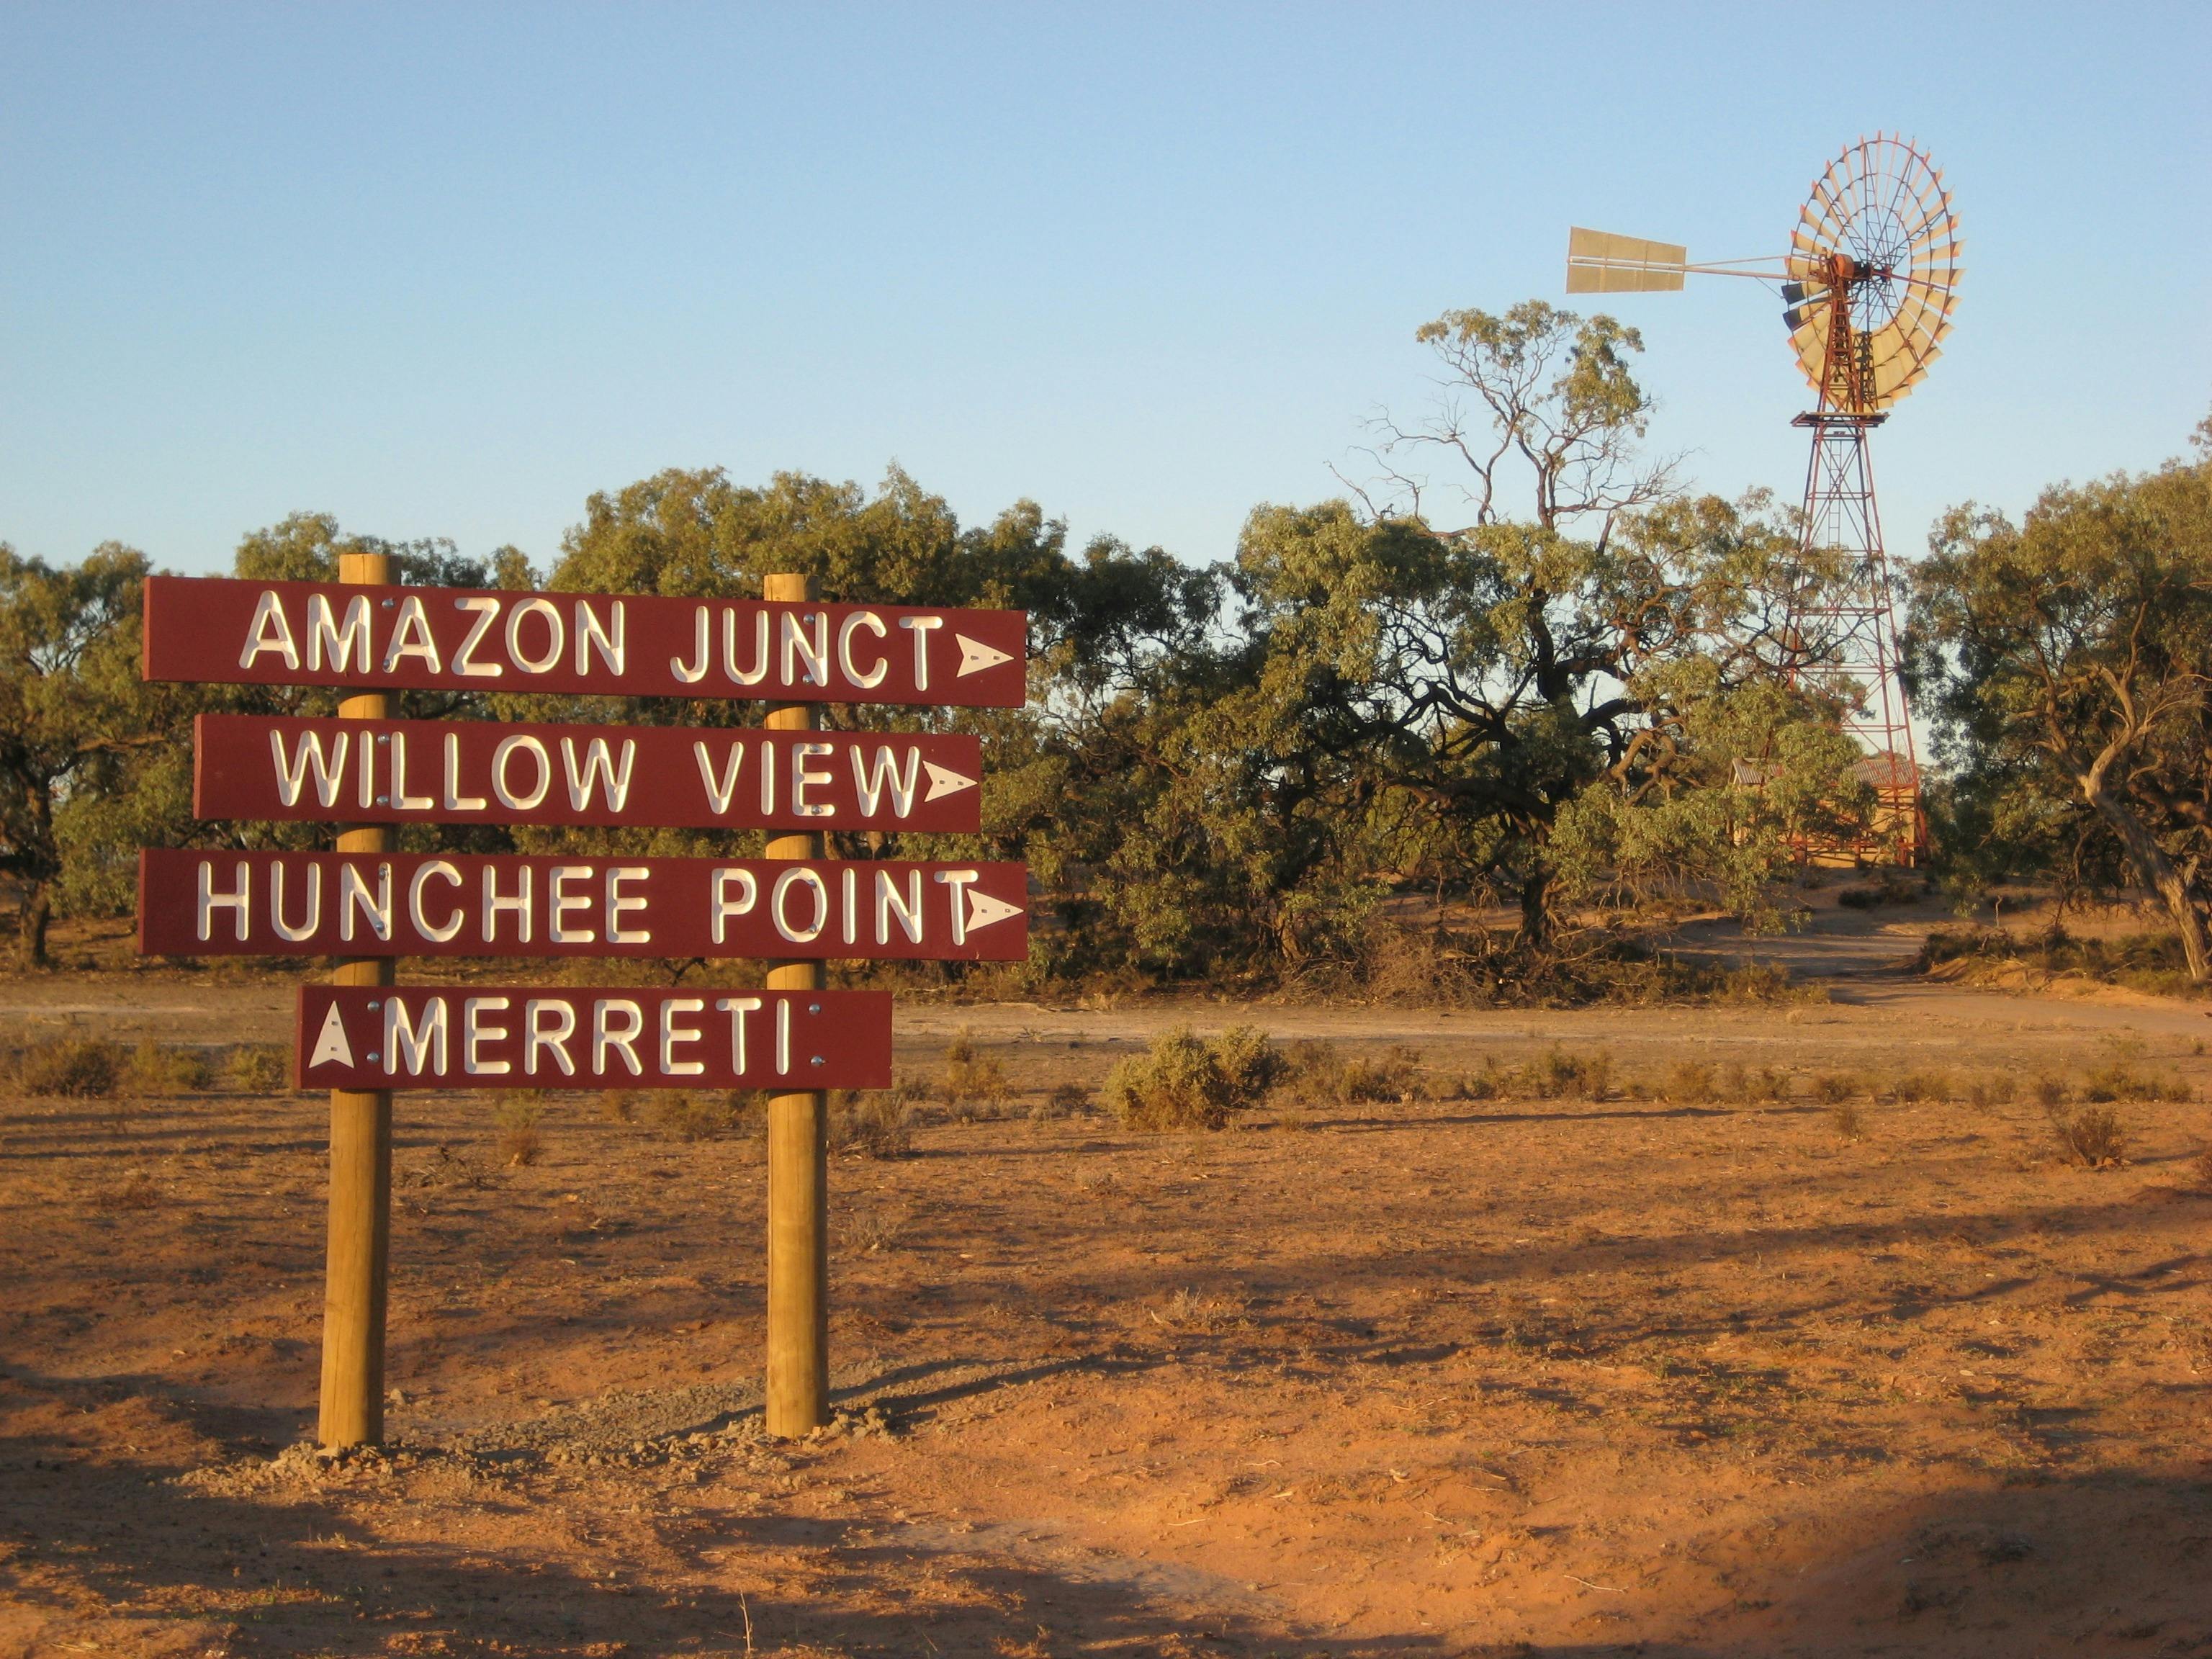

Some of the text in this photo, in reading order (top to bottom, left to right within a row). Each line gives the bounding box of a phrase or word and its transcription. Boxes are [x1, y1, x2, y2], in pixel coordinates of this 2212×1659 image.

[239, 590, 943, 691] AMAZON JUNCT
[270, 729, 920, 819] WILLOW VIEW
[197, 860, 979, 946] HUNCHEE POINT
[383, 996, 789, 1076] MERRETI
